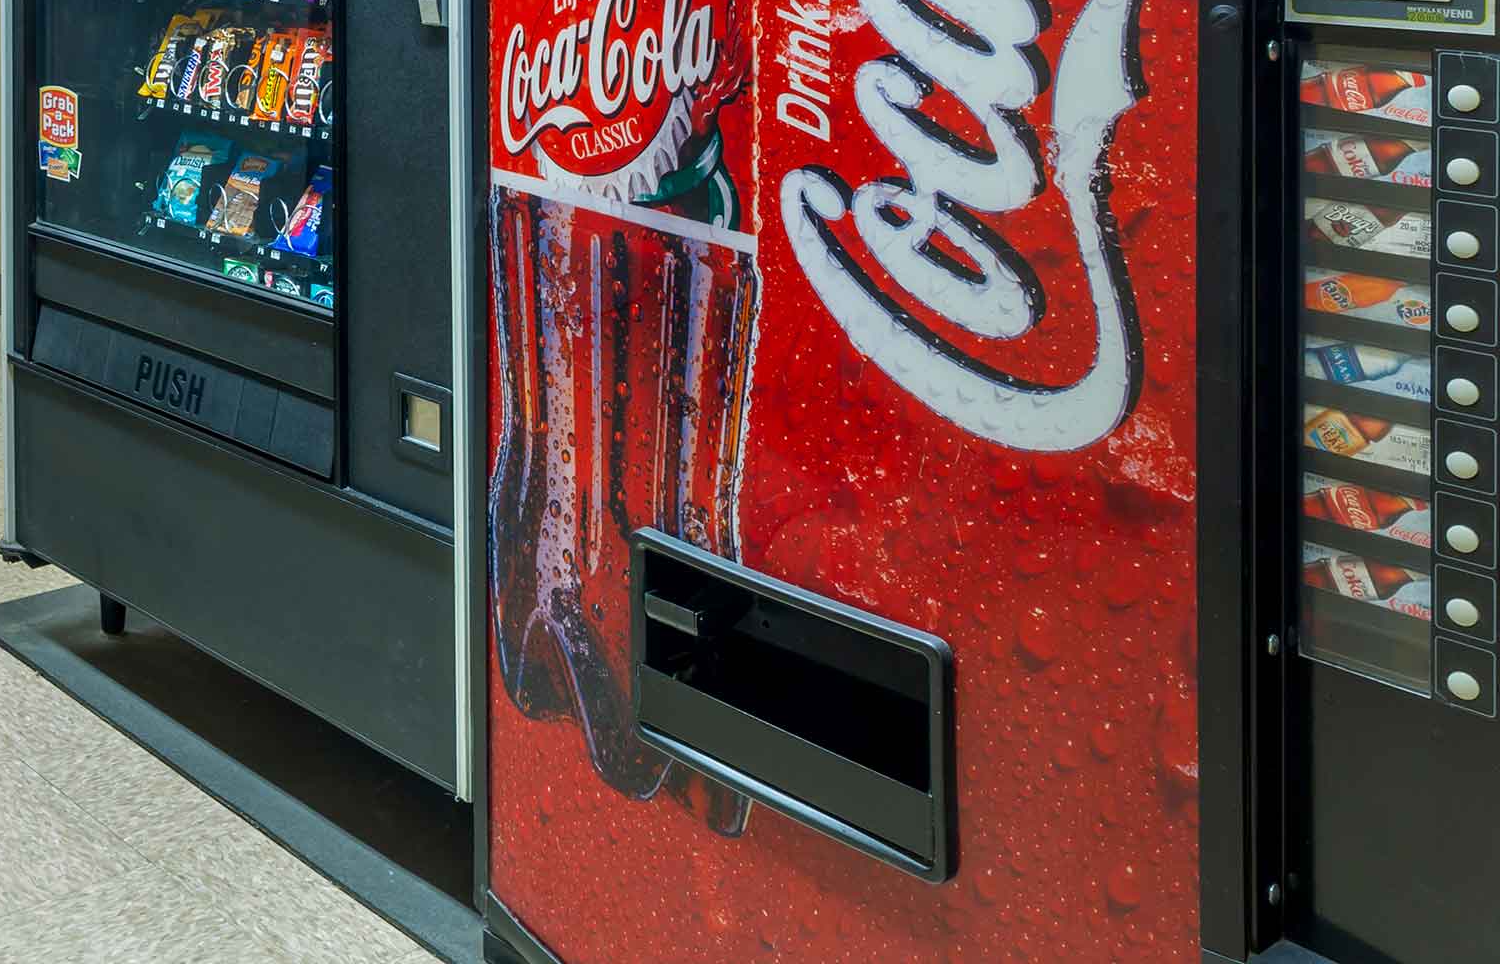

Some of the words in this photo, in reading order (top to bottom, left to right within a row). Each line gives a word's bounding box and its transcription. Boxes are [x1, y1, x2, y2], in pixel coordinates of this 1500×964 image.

[178, 49, 200, 99] SNICKERS
[43, 91, 74, 115] Grab
[55, 110, 62, 121] a
[43, 113, 75, 138] Pack
[571, 118, 643, 160] CLASSIC
[134, 353, 206, 416] PUSH
